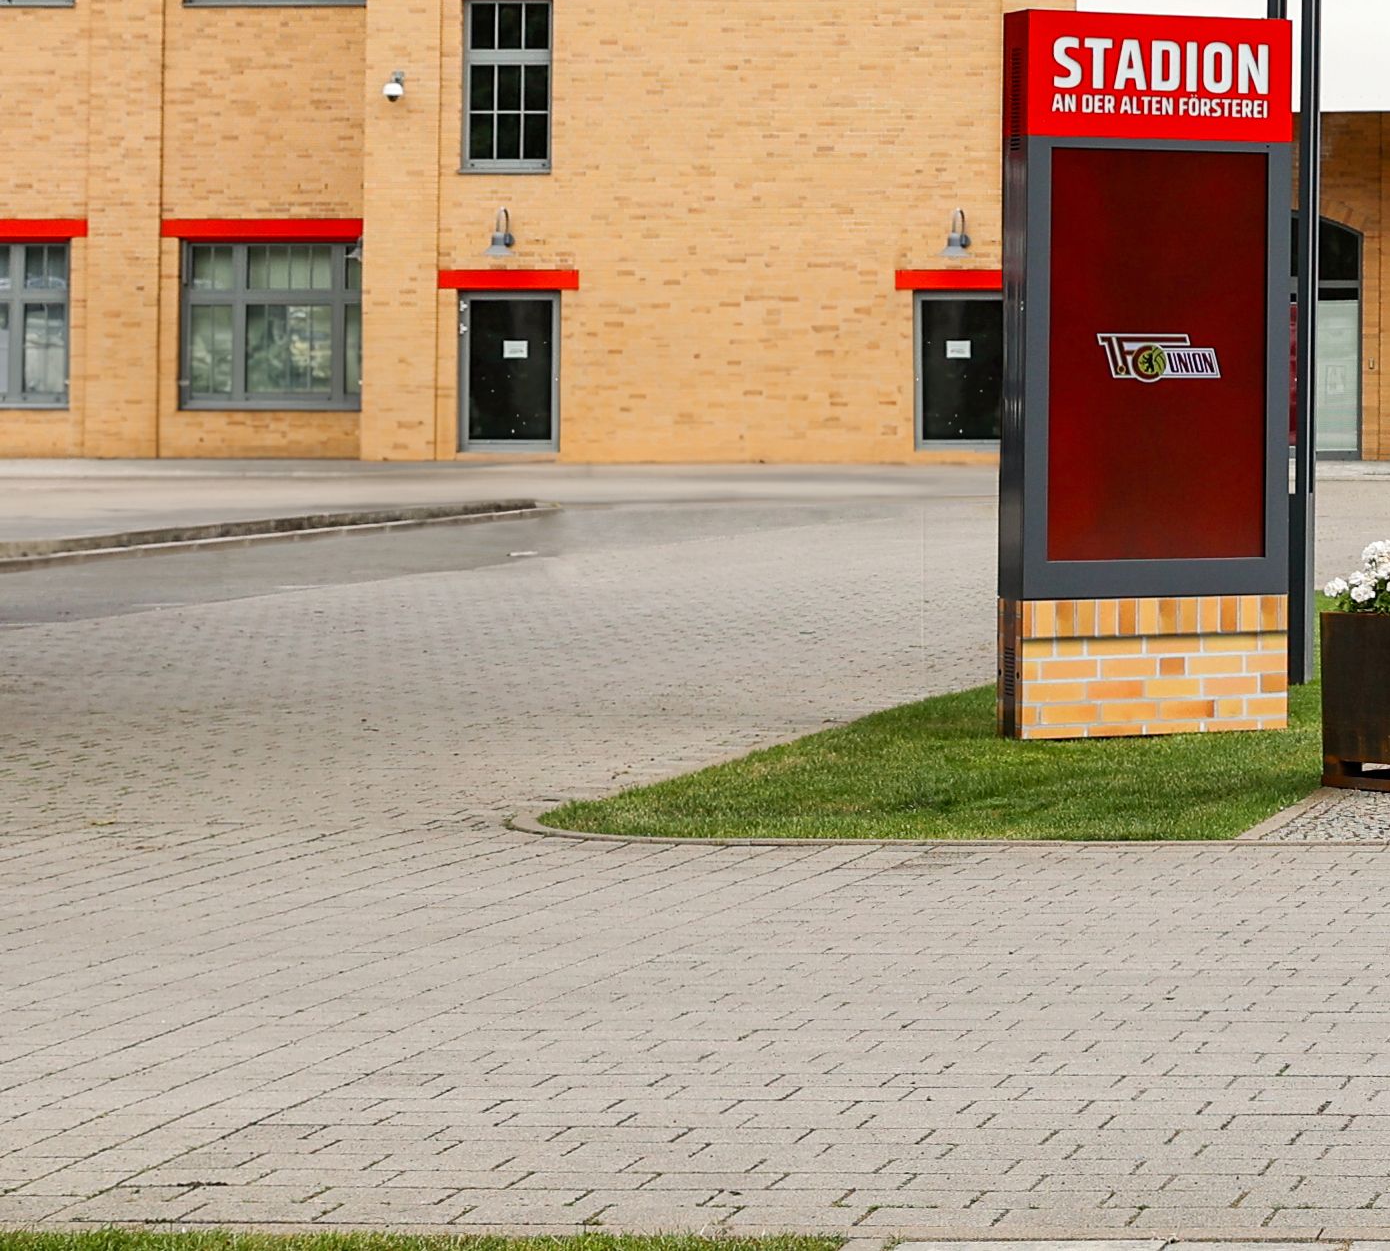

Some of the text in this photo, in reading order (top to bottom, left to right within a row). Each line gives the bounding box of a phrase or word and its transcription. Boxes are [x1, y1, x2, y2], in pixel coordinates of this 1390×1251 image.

[1053, 36, 1270, 95] STADION
[1051, 93, 1269, 119] AN DER ALTEN FÖRSTEREI
[1166, 352, 1216, 374] UNION
